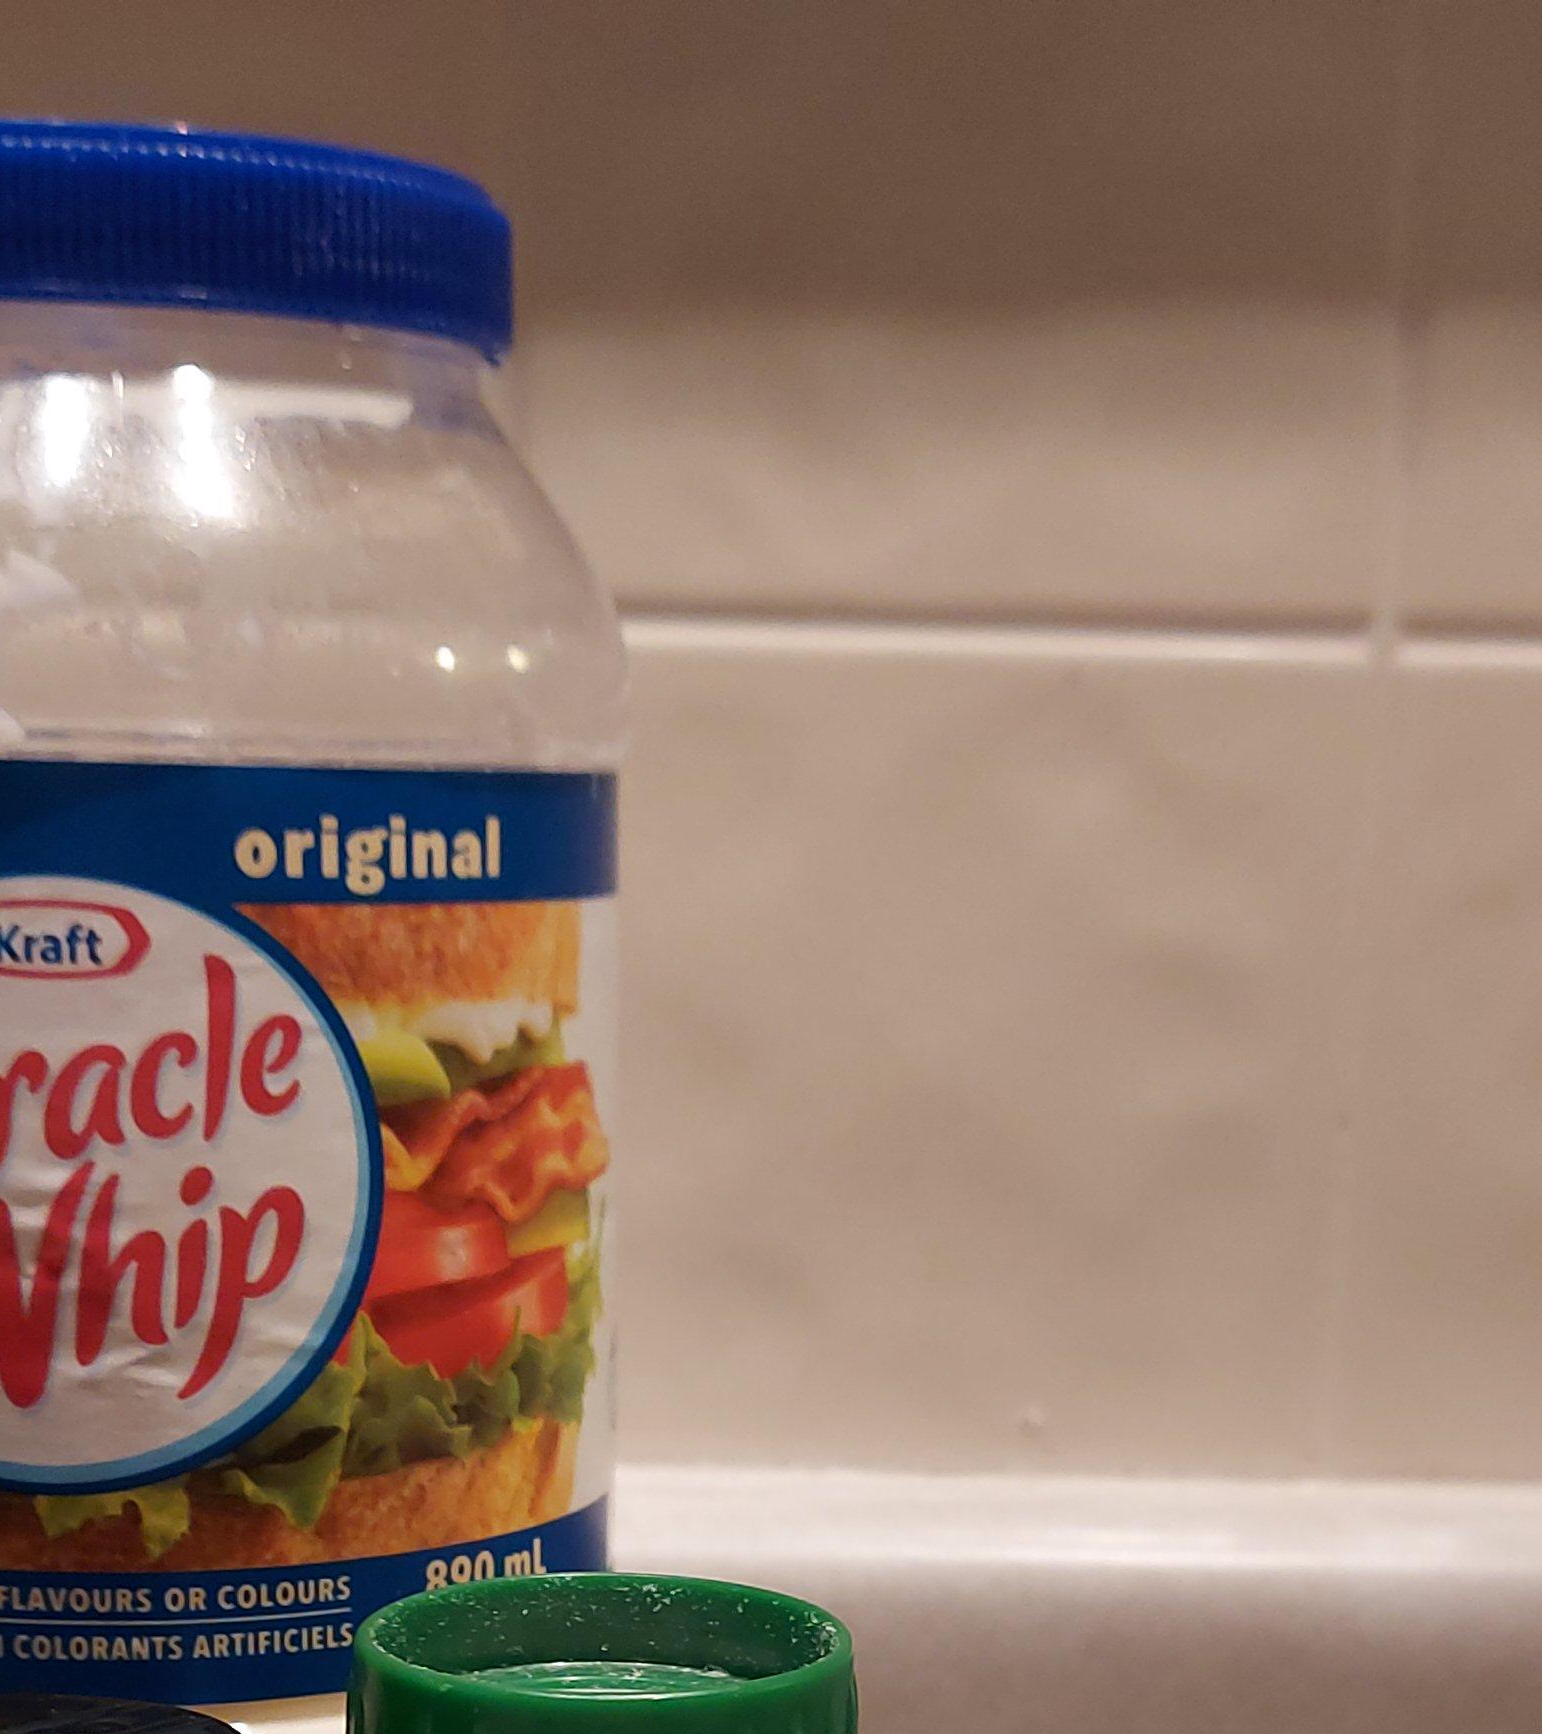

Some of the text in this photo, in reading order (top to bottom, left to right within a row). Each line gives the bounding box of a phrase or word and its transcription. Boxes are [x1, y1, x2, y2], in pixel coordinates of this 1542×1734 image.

[235, 817, 501, 896] original
[164, 1586, 206, 1612] OR
[217, 1574, 352, 1610] COLOURS
[13, 1633, 183, 1661] COLORANTS
[192, 1621, 355, 1660] ARTIFICIELS
